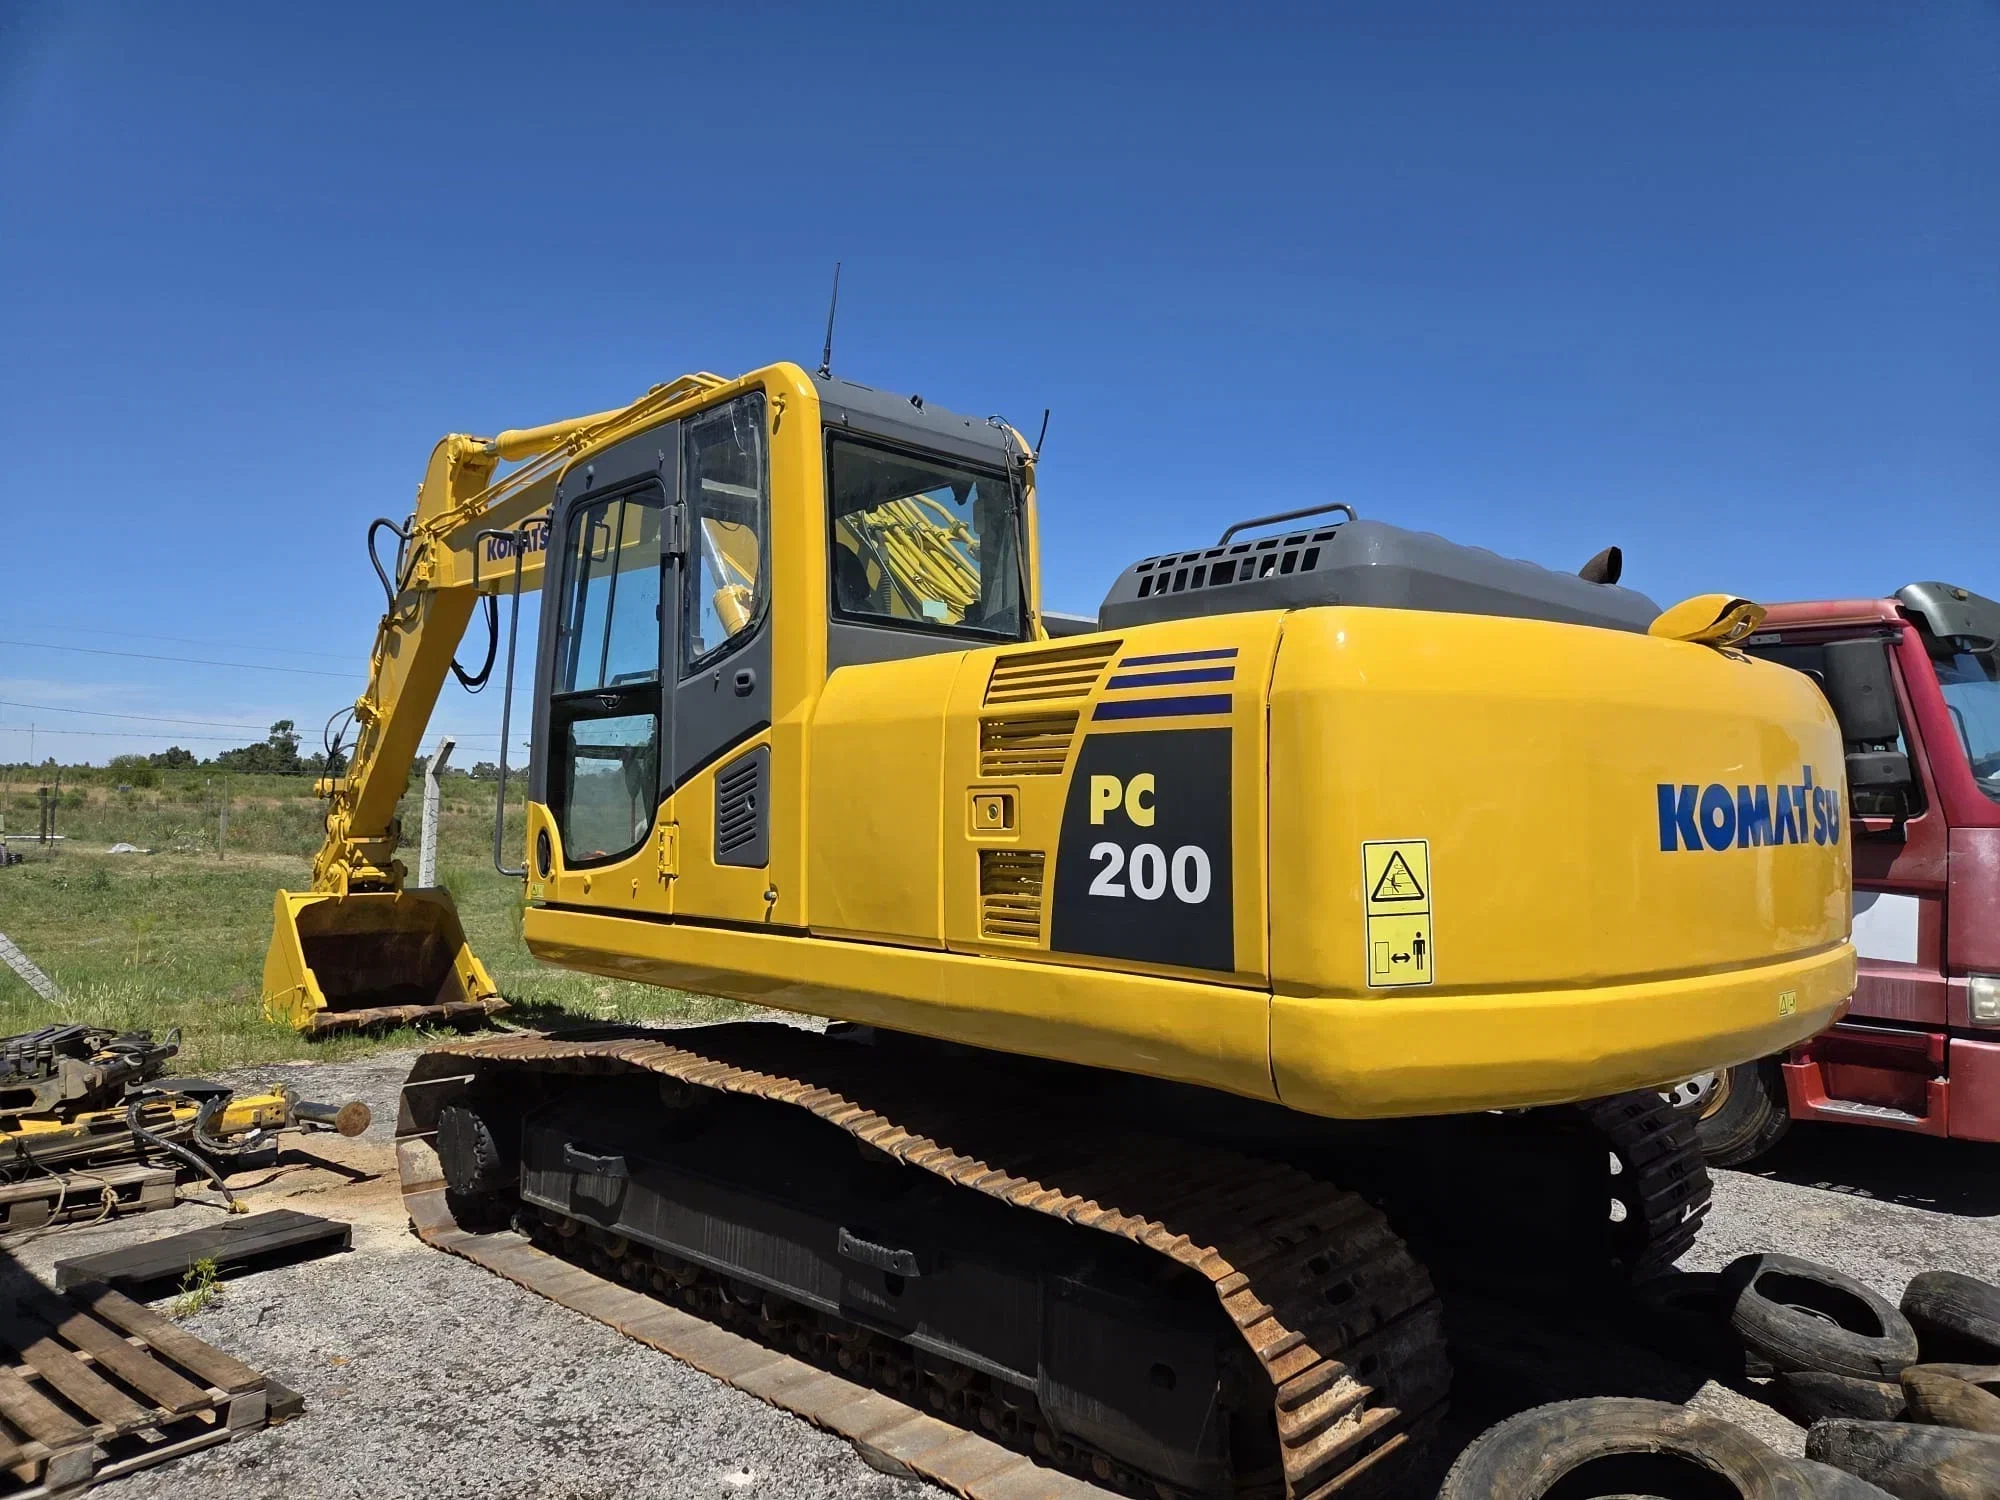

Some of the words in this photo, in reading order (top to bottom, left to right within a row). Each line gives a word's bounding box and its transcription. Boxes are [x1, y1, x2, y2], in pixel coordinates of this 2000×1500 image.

[487, 523, 549, 561] KOMATS
[1090, 773, 1155, 827] PC
[1657, 765, 1840, 851] KOMATSU
[1088, 842, 1211, 903] 200
